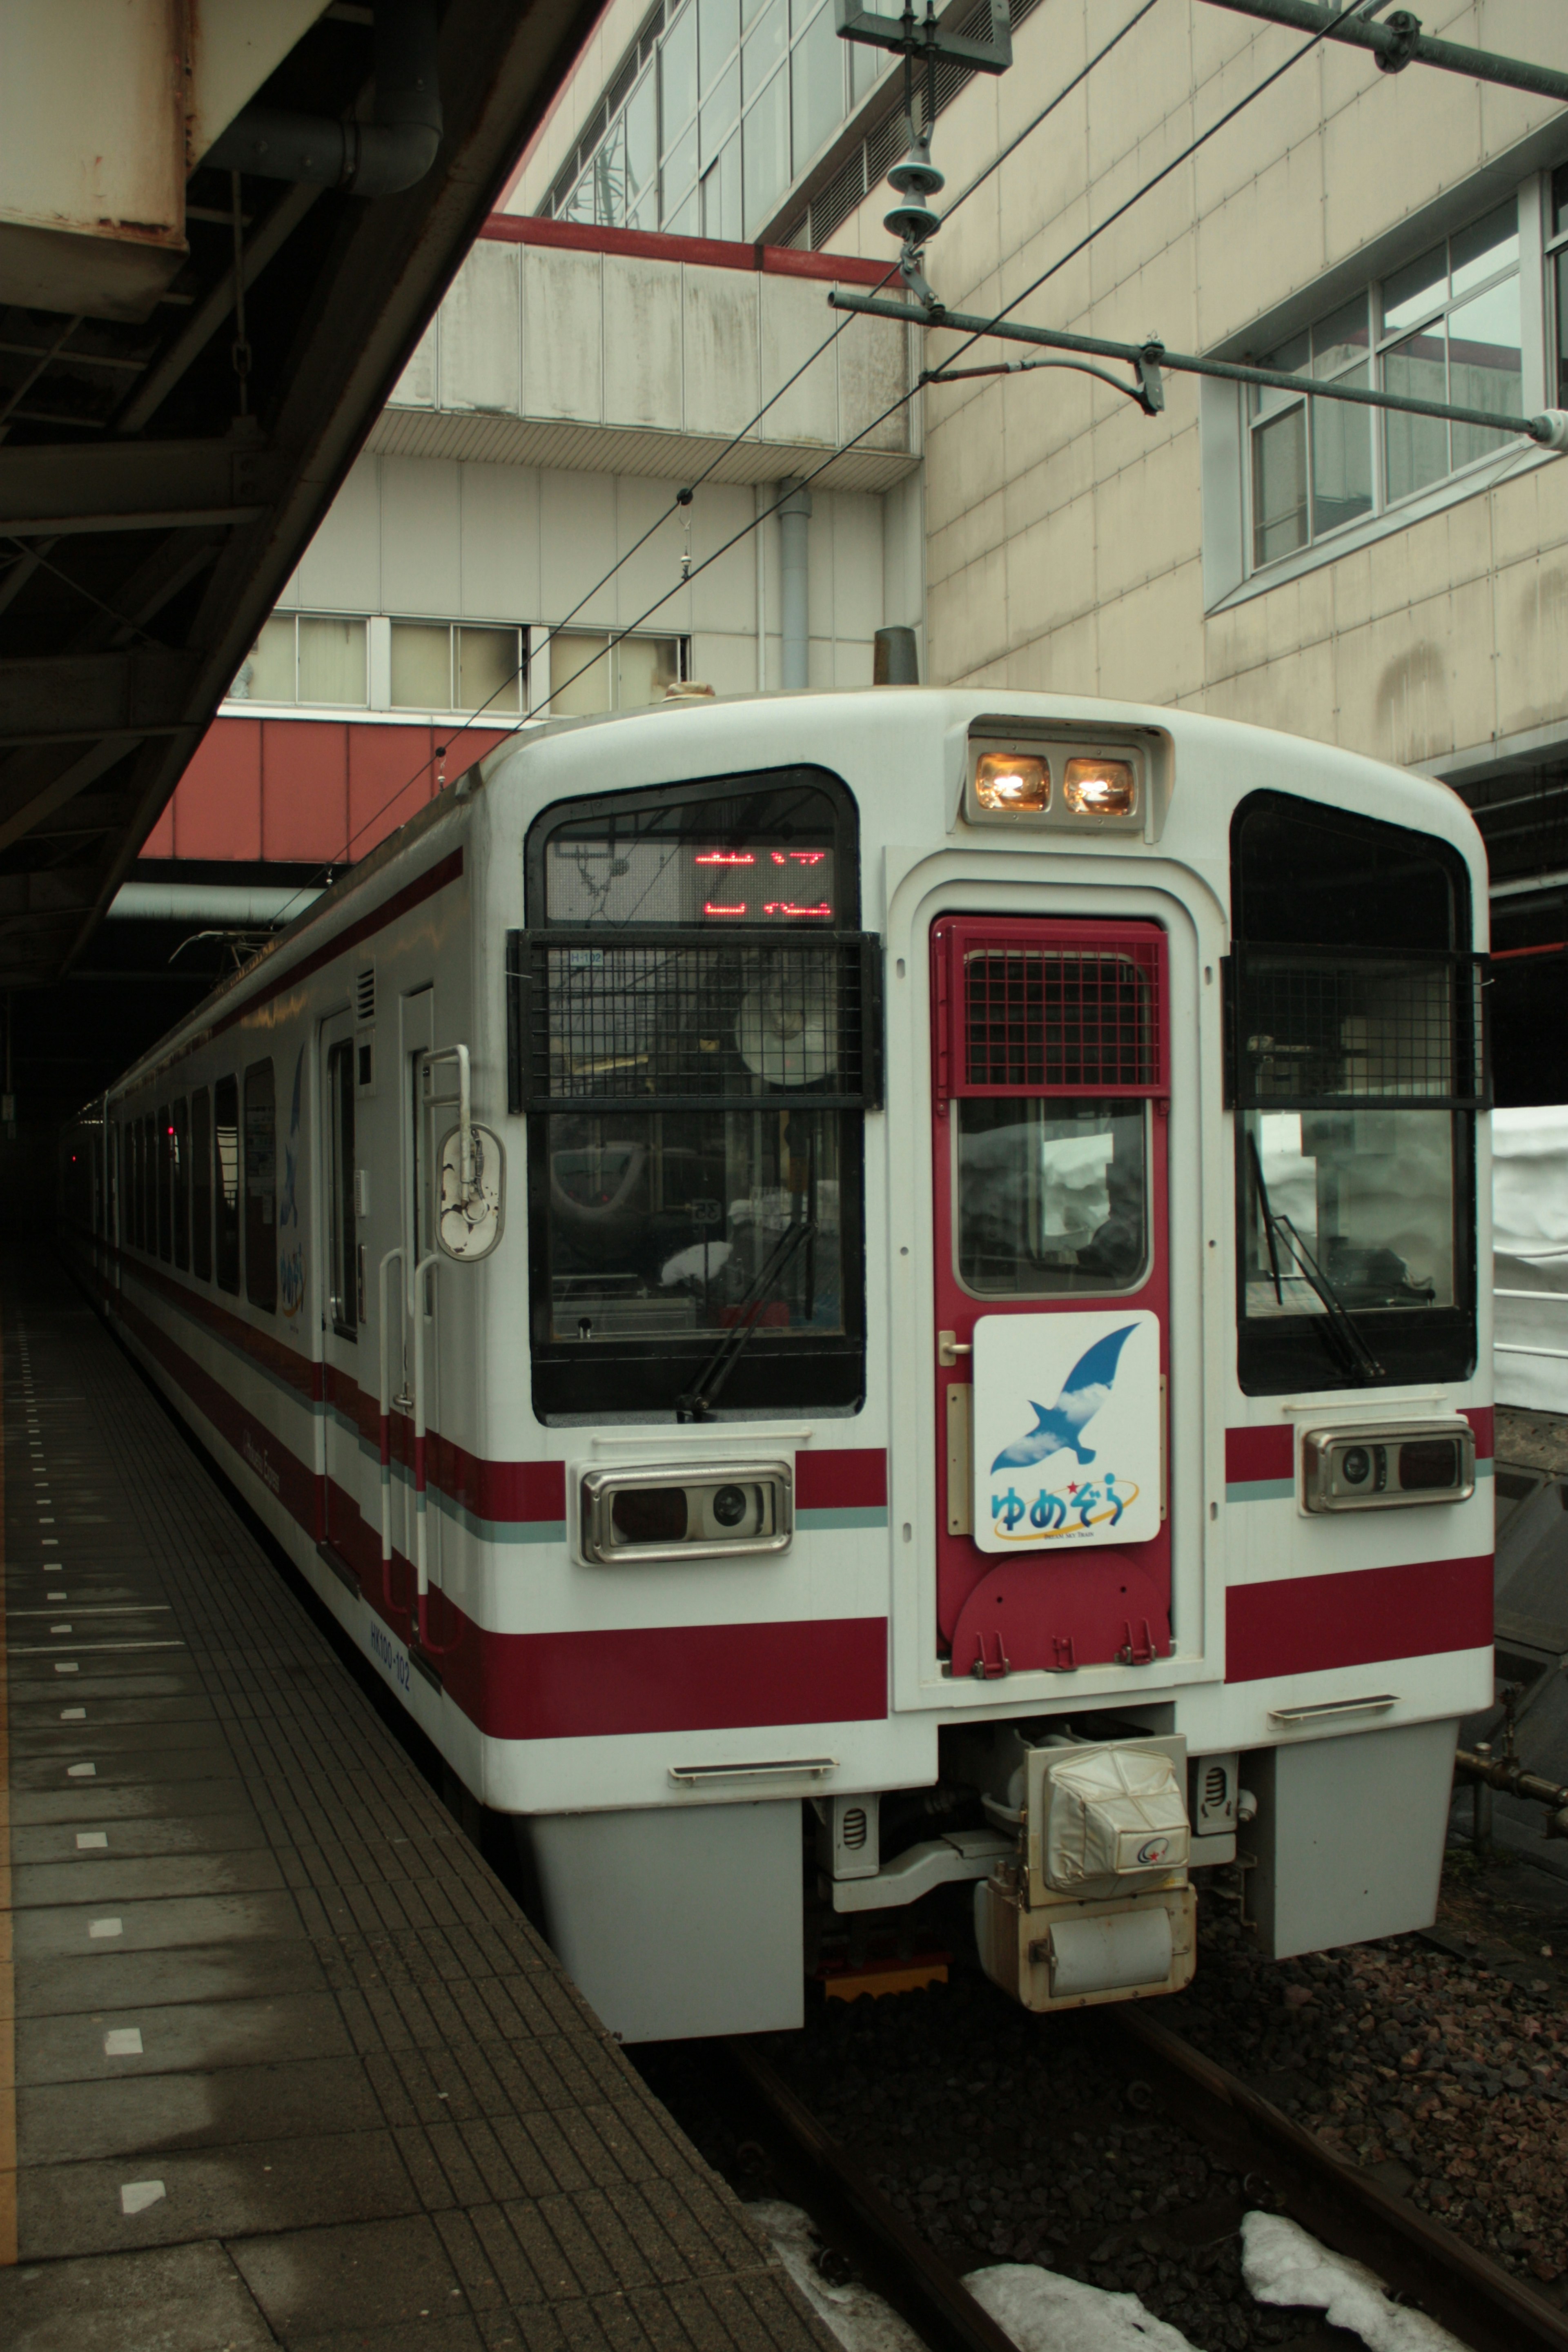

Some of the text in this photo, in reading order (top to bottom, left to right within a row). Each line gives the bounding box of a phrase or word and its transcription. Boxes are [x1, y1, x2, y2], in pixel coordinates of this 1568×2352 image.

[572, 953, 601, 962] H-102
[991, 1473, 1124, 1530] ゆめぞら
[371, 1620, 410, 1692] HK100-102
